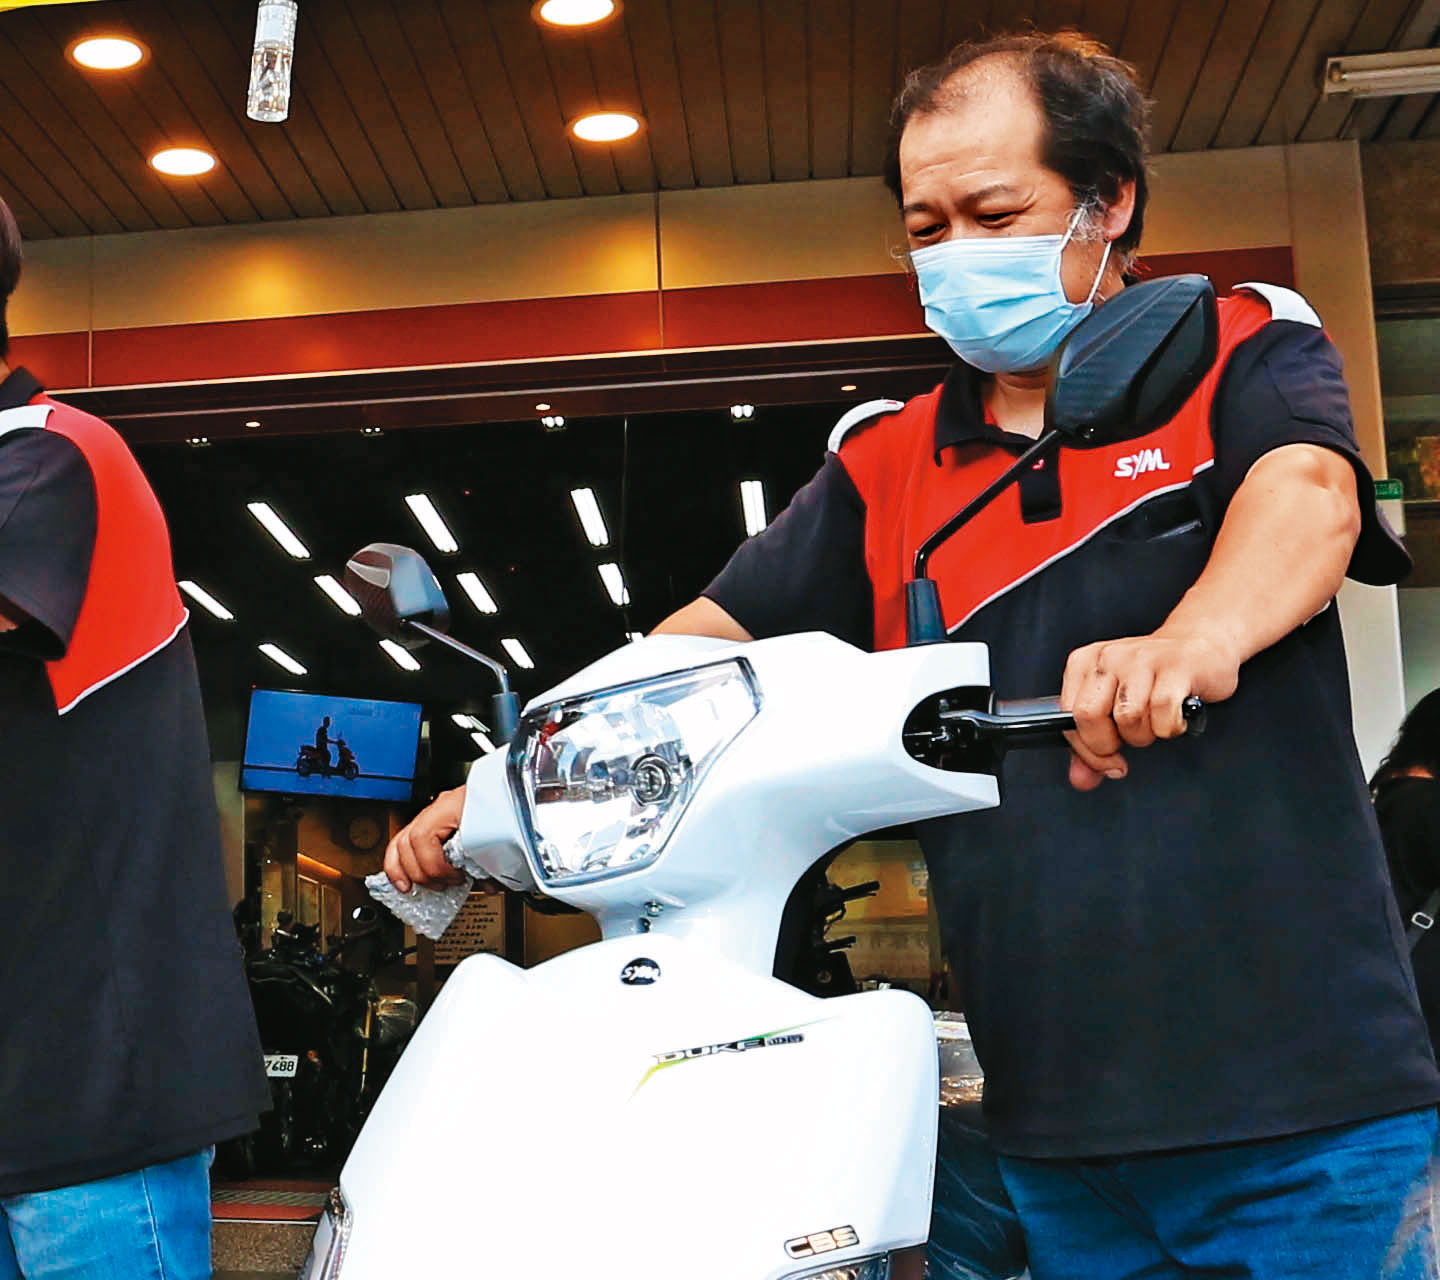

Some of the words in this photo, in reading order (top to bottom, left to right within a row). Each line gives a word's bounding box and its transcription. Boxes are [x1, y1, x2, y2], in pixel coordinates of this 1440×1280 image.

[1114, 447, 1170, 480] SYM
[653, 1036, 766, 1065] DUKE
[784, 1224, 860, 1260] CBS
